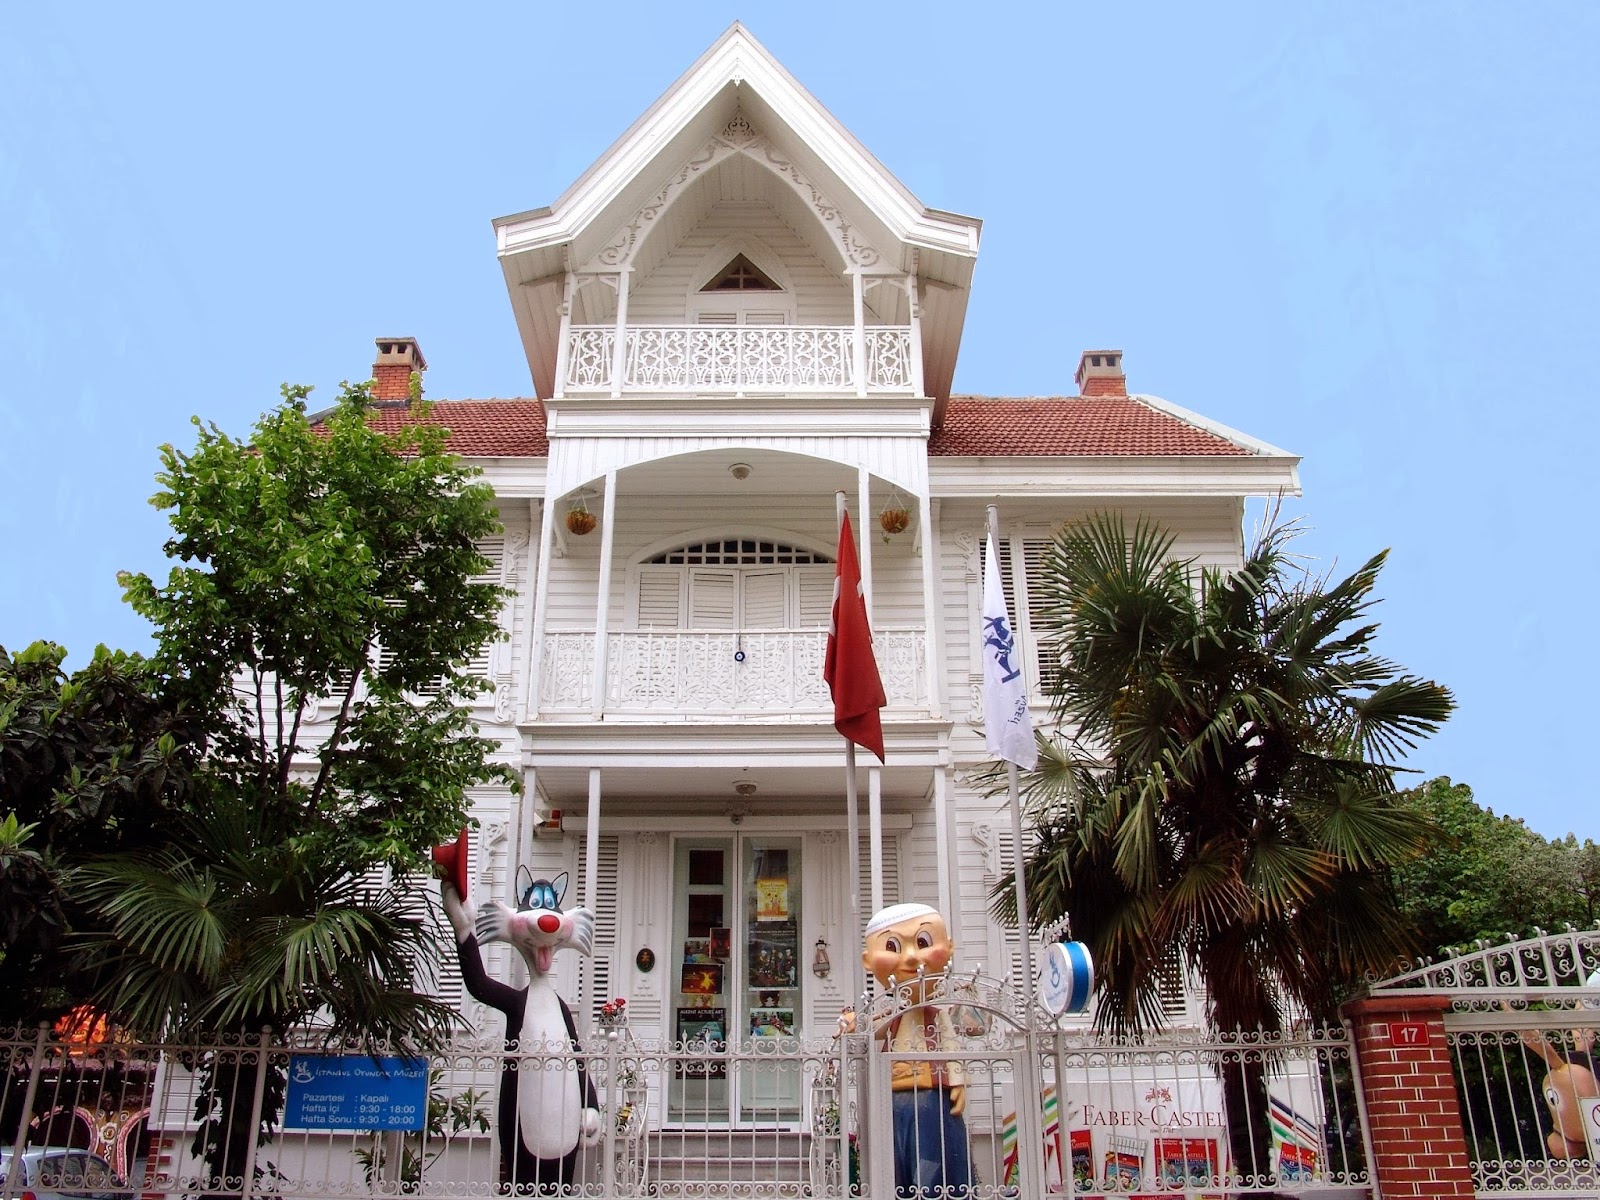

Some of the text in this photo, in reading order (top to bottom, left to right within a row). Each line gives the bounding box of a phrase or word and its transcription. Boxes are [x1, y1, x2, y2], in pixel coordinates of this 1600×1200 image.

[1400, 1027, 1418, 1043] 17
[302, 1093, 345, 1102] Pazartesi
[360, 1094, 389, 1104] Kapalı
[301, 1104, 327, 1113] Hafta
[329, 1102, 340, 1115] İçi
[360, 1105, 380, 1114] 9:30
[389, 1105, 416, 1114] 18:00
[300, 1115, 326, 1123] Hafta
[359, 1116, 379, 1124] 9:30
[388, 1116, 415, 1125] 20:00
[1082, 1104, 1226, 1127] FABER-CASTEL
